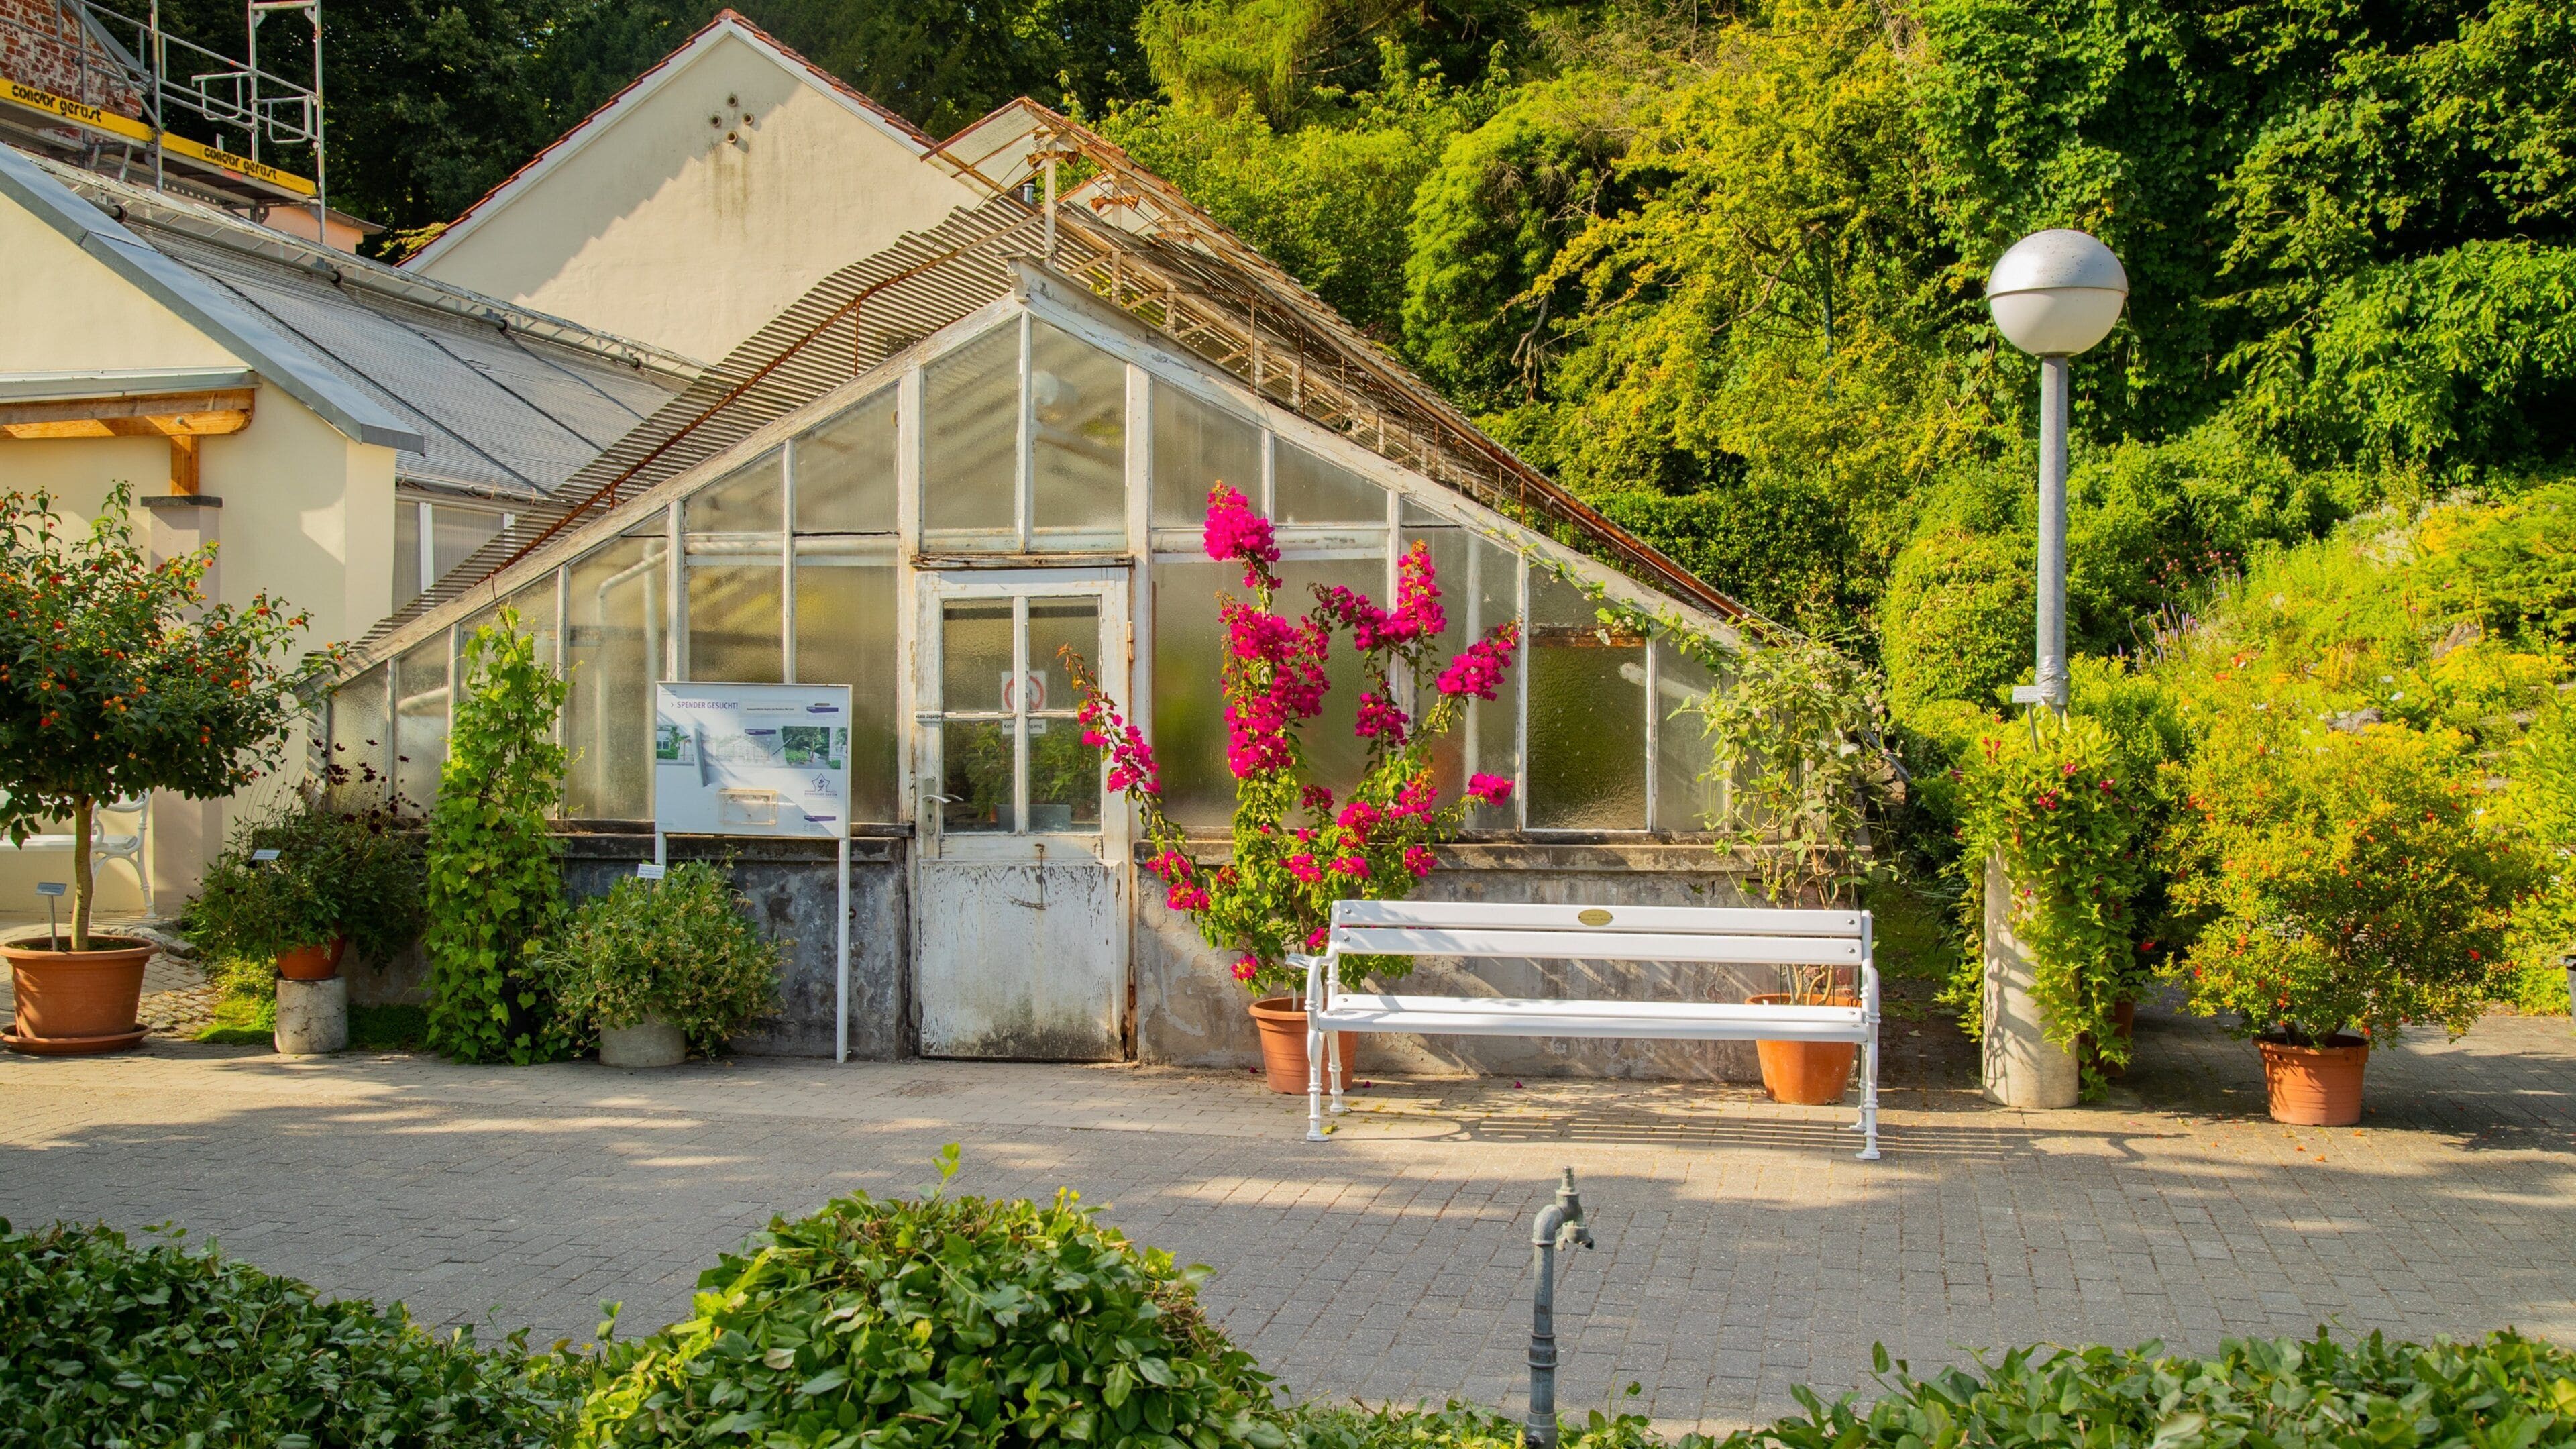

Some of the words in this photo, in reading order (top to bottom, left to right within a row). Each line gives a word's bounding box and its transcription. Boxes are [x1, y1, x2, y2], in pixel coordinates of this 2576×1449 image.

[12, 85, 56, 107] condor
[204, 148, 240, 167] condor
[677, 701, 706, 709] SPENDER
[707, 702, 739, 710] GESUCHT!
